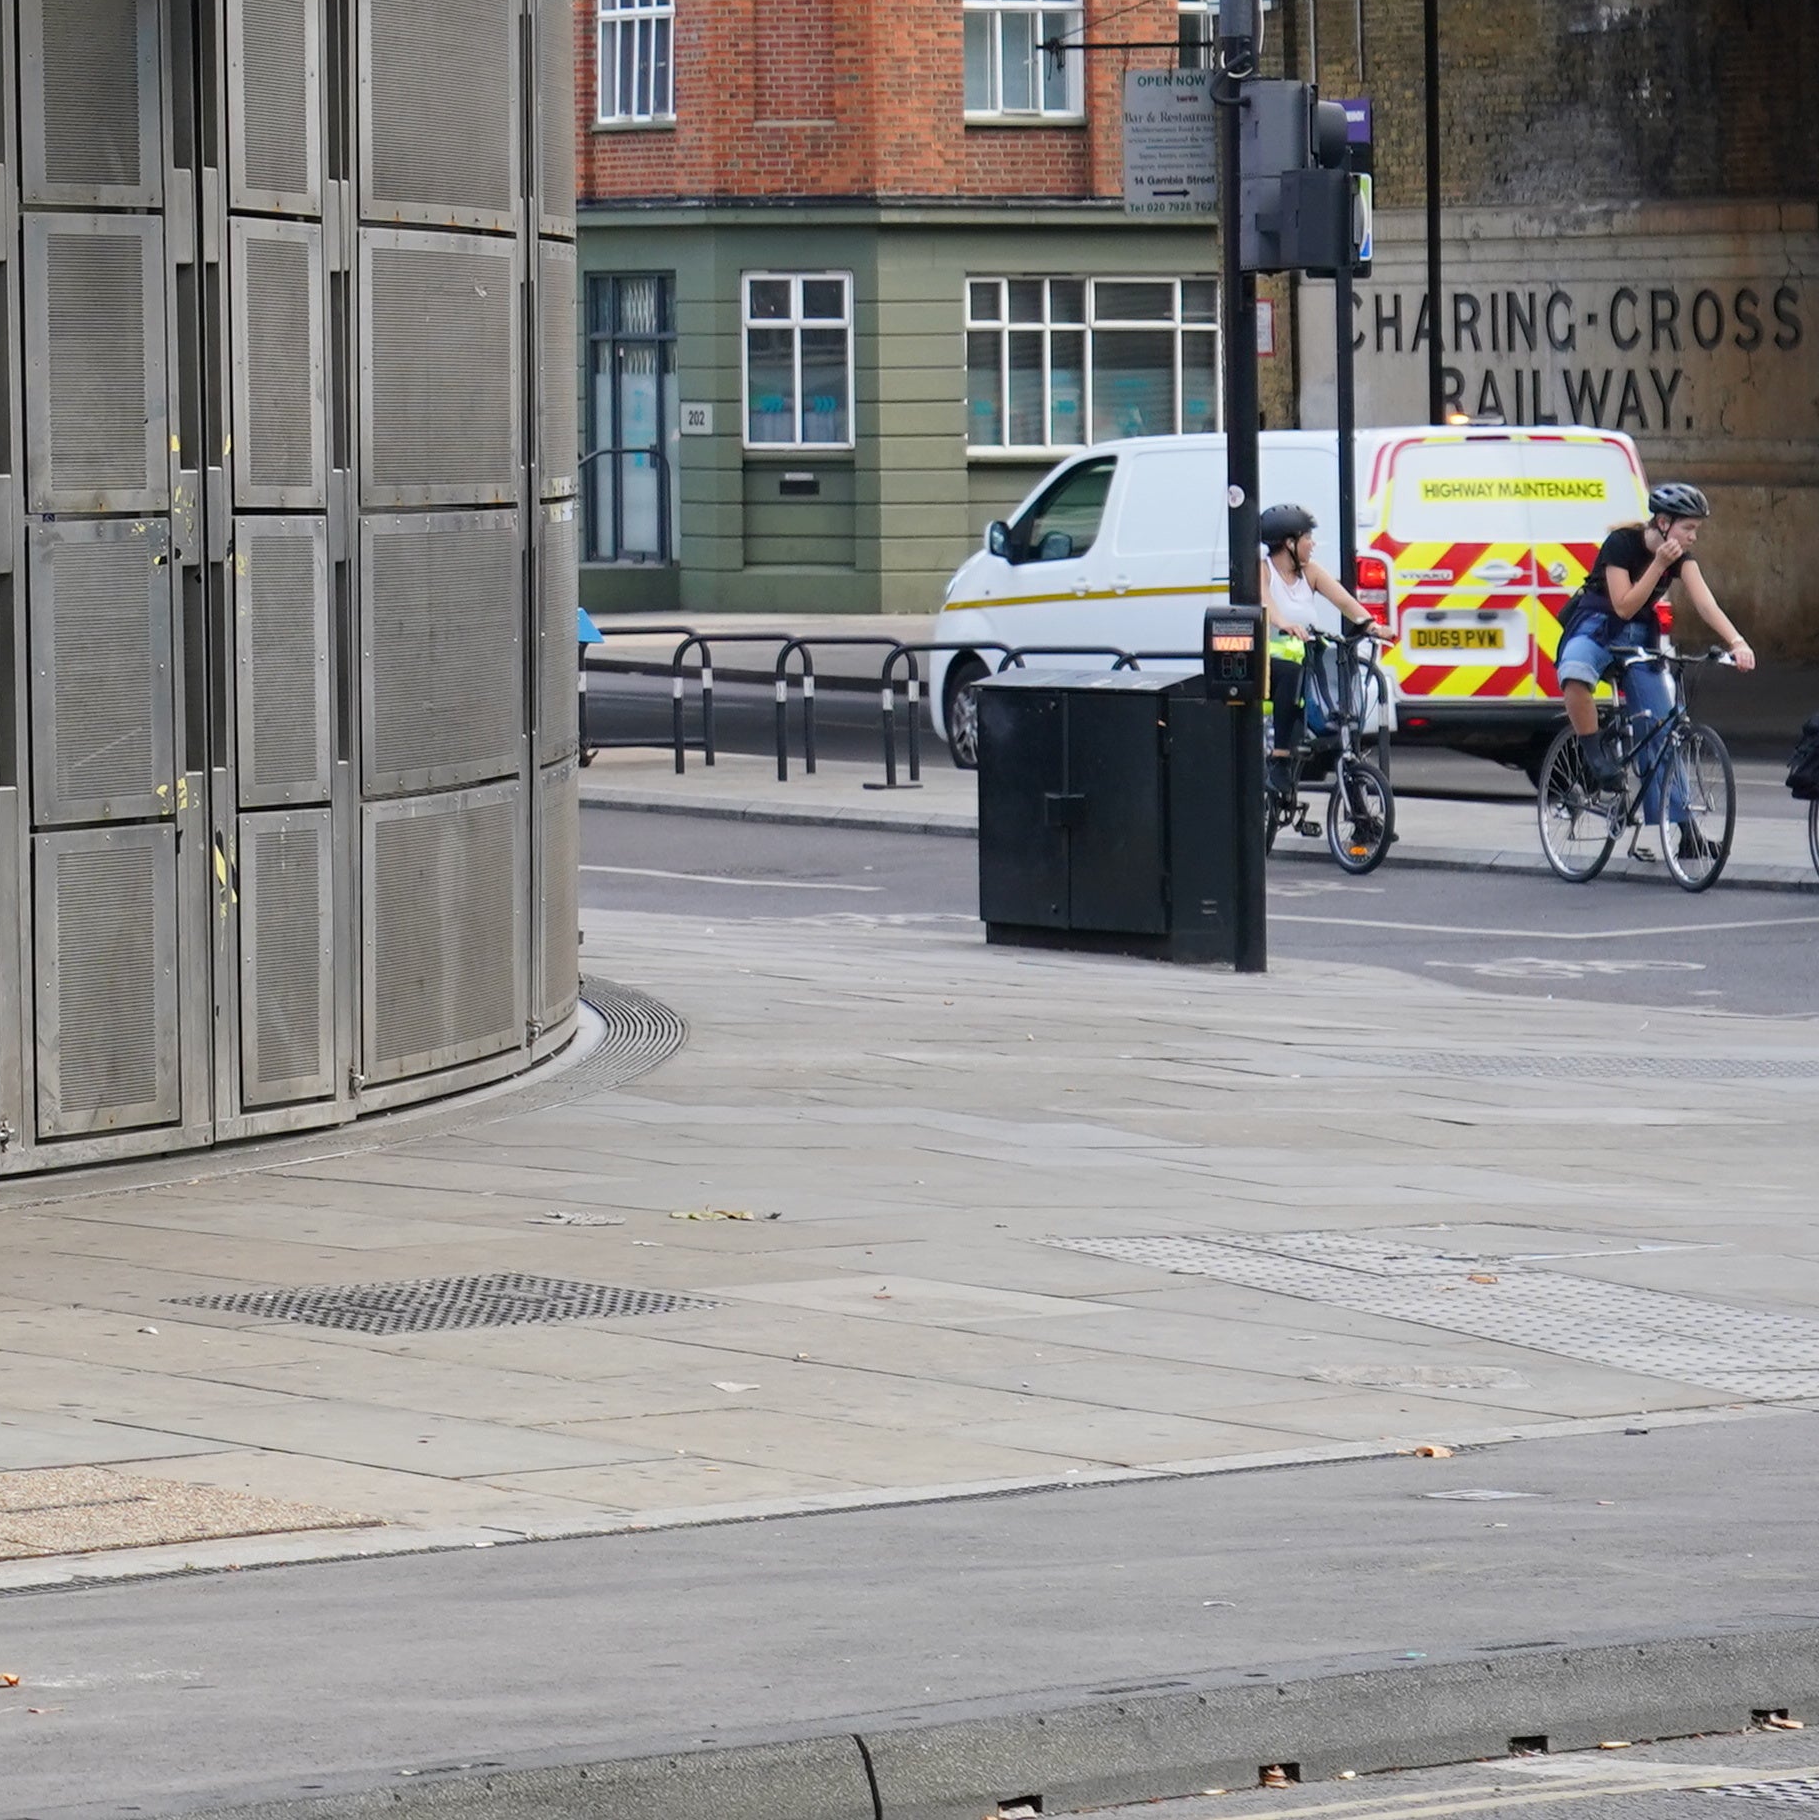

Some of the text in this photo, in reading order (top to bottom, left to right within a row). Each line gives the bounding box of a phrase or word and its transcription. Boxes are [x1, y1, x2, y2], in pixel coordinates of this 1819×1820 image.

[1137, 74, 1207, 87] OPEN NOW
[1124, 111, 1214, 124] Bar & Restauran
[1134, 174, 1215, 185] 14 Gambia Street
[1130, 203, 1144, 213] Tel
[1147, 203, 1165, 212] 020
[688, 409, 705, 426] 202
[1424, 482, 1604, 497] HIGHWAY MAINTENANCE
[1216, 637, 1250, 650] WAIT
[1416, 630, 1461, 646] DU69
